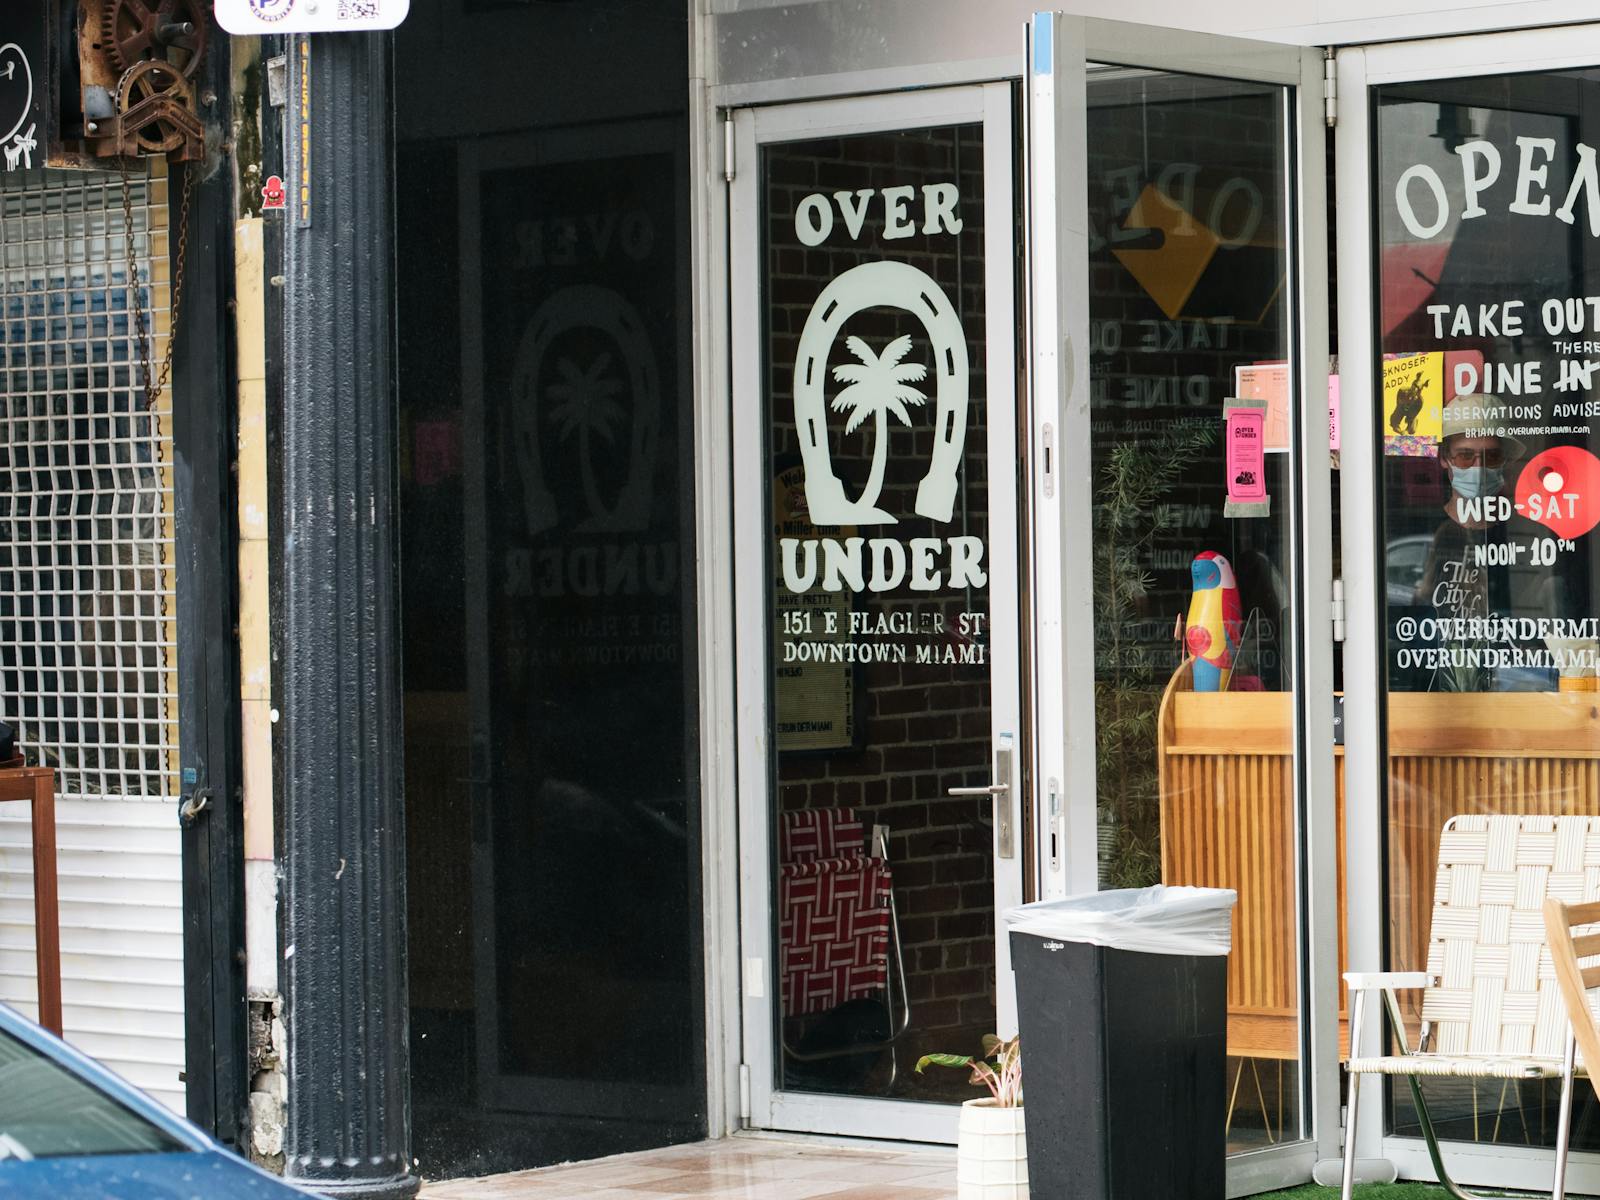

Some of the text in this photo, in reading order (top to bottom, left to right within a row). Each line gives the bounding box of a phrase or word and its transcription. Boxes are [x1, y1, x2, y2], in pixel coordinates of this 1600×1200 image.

[795, 183, 963, 246] OVER
[1427, 300, 1524, 339] TAKE
[1553, 341, 1600, 354] THERE
[1453, 361, 1541, 396] DINE
[1464, 427, 1495, 438] BRIAN
[780, 536, 988, 592] UNDER
[783, 612, 985, 636] 151 E FLAGLER ST
[784, 642, 985, 665] DOWNTOWN MIAMI
